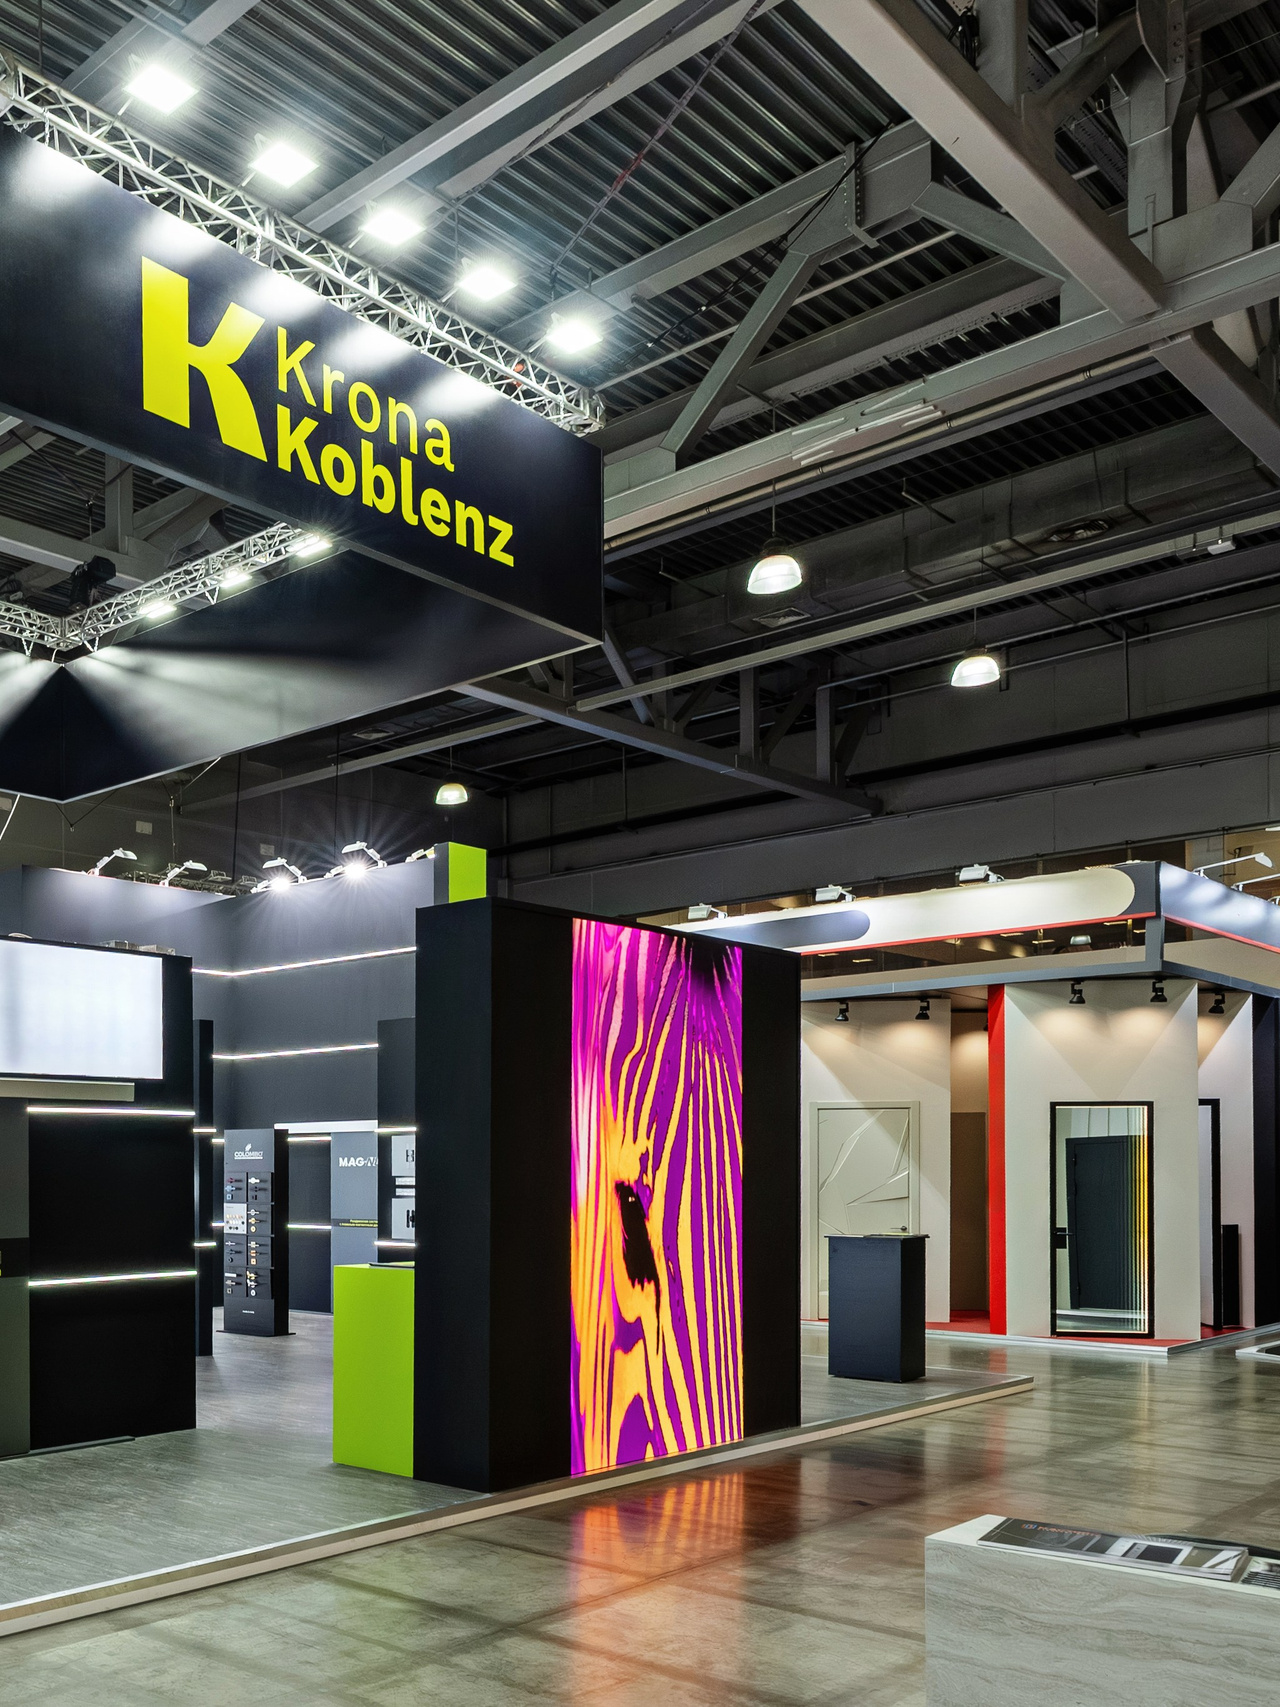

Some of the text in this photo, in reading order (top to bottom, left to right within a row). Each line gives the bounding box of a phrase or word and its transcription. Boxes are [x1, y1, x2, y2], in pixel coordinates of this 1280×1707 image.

[141, 256, 268, 462] K
[277, 325, 455, 473] Krona
[277, 404, 515, 568] Koblenz
